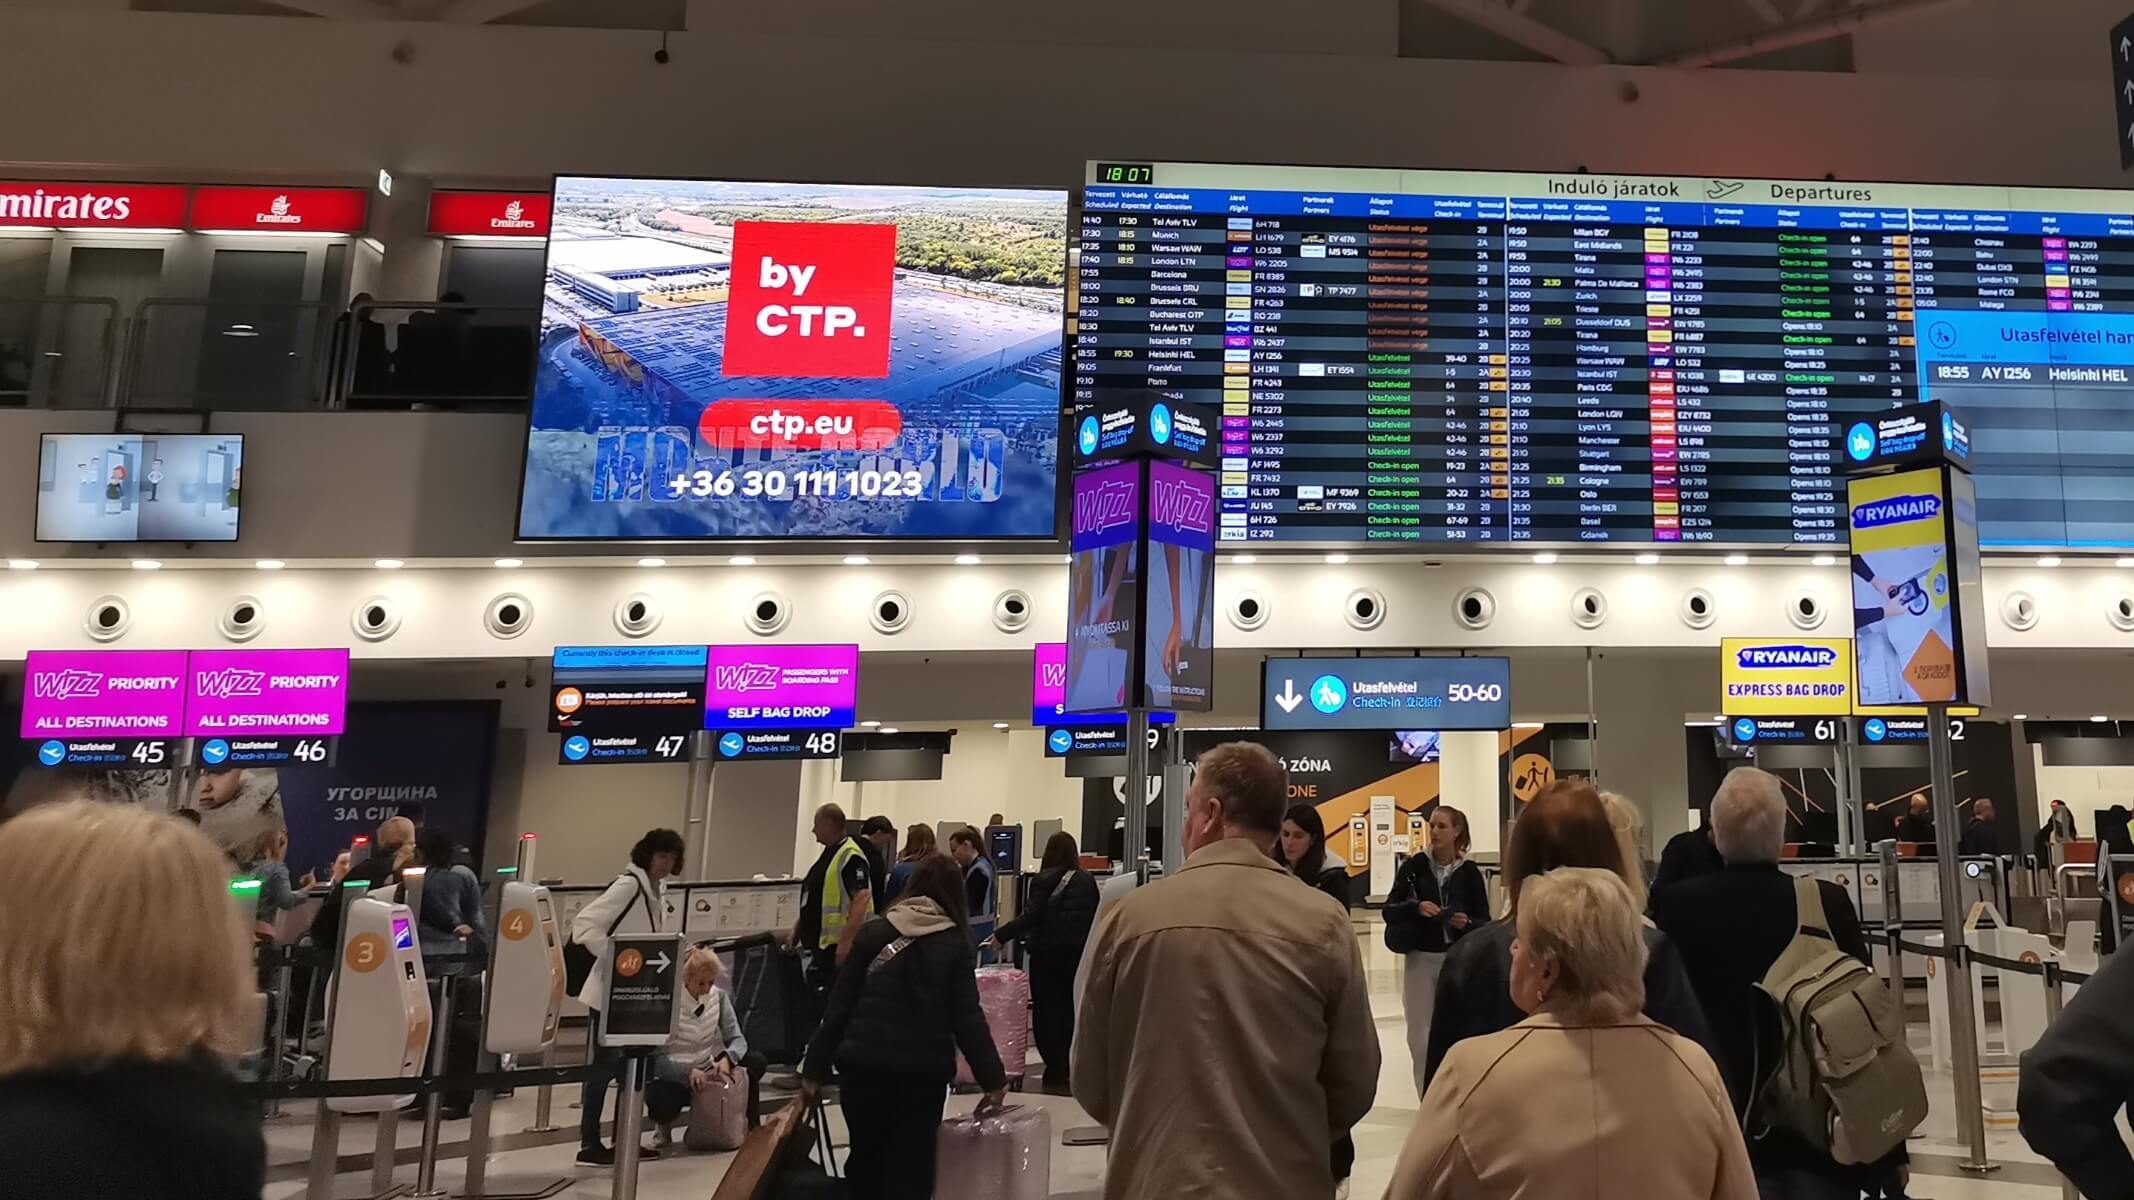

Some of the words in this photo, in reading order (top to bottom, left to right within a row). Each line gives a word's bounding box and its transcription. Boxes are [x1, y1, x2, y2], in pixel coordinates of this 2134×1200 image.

[1548, 178, 1607, 195] Induló
[1613, 179, 1680, 198] járatok
[1770, 183, 1872, 203] Departures
[0, 188, 130, 220] mirates
[256, 213, 302, 223] Emirates
[491, 218, 535, 229] Emirates
[1119, 217, 1138, 225] 17:30
[1152, 218, 1164, 226] Tel
[1182, 219, 1197, 227] TLV
[1082, 229, 1101, 237] 17:30
[1152, 231, 1179, 239] Munich
[1151, 244, 1180, 252] Warsaw
[1081, 256, 1100, 264] 17:40
[1151, 257, 1179, 265] London
[1180, 258, 1196, 266] LTN
[759, 256, 816, 296] by
[1151, 271, 1187, 279] Barcelona
[1150, 297, 1181, 305] Brussels
[1575, 292, 1597, 300] Zurich
[755, 304, 866, 338] CTP.
[1149, 310, 1186, 318] Bucharest
[1188, 311, 1204, 319] OTP
[1149, 337, 1178, 345] Istanbul
[2001, 327, 2101, 344] Utasfelvétel
[1148, 364, 1182, 372] Frankfurt
[1937, 366, 1969, 379] 18:55
[1981, 366, 2001, 380] AY
[2003, 367, 2031, 380] 1256
[2049, 367, 2100, 381] Helsinki
[2102, 369, 2128, 381] HEL
[1147, 378, 1168, 386] Porto
[1578, 410, 1604, 418] London
[750, 409, 853, 441] ctp.eu
[1578, 424, 1595, 432] Lyon
[1368, 462, 1400, 470] Check-in
[1401, 463, 1420, 471] open
[670, 470, 735, 497] +36
[742, 470, 786, 497] 30
[793, 470, 837, 496] 111
[845, 470, 922, 496] 1023
[1579, 477, 1609, 486] Cologne
[1866, 500, 1936, 521] RYANAIR
[562, 650, 597, 658] Currently
[599, 649, 613, 657] this
[1753, 650, 1832, 664] RYANAIR
[830, 668, 849, 676] WITH
[108, 677, 179, 690] PRIORITY
[270, 675, 340, 689] PRIORITY
[1353, 681, 1418, 693] Utasfelvétel
[1448, 683, 1502, 702] 50-60
[1728, 684, 1782, 696] EXPRESS
[1786, 684, 1810, 696] BAG
[1813, 683, 1845, 696] DROP
[1353, 696, 1401, 708] Check-in
[728, 707, 760, 718] SELF
[762, 706, 790, 718] BAG
[793, 706, 831, 718] DROP
[35, 717, 63, 728] ALL
[65, 716, 168, 728] DESTINATIONS
[198, 715, 226, 727] ALL
[228, 713, 330, 727] DESTINATIONS
[1815, 720, 1835, 740] 61
[1948, 720, 1965, 740] 2
[805, 732, 836, 754] 48
[1147, 728, 1159, 749] 9
[132, 741, 165, 764] 45
[293, 739, 326, 762] 46
[655, 735, 684, 757] 47
[1290, 757, 1332, 772] ZÓNA
[326, 786, 438, 801] УГОРЩИНА
[1287, 785, 1317, 798] ONE
[334, 807, 359, 821] ЗА
[509, 917, 525, 932] 4
[358, 944, 374, 963] 3
